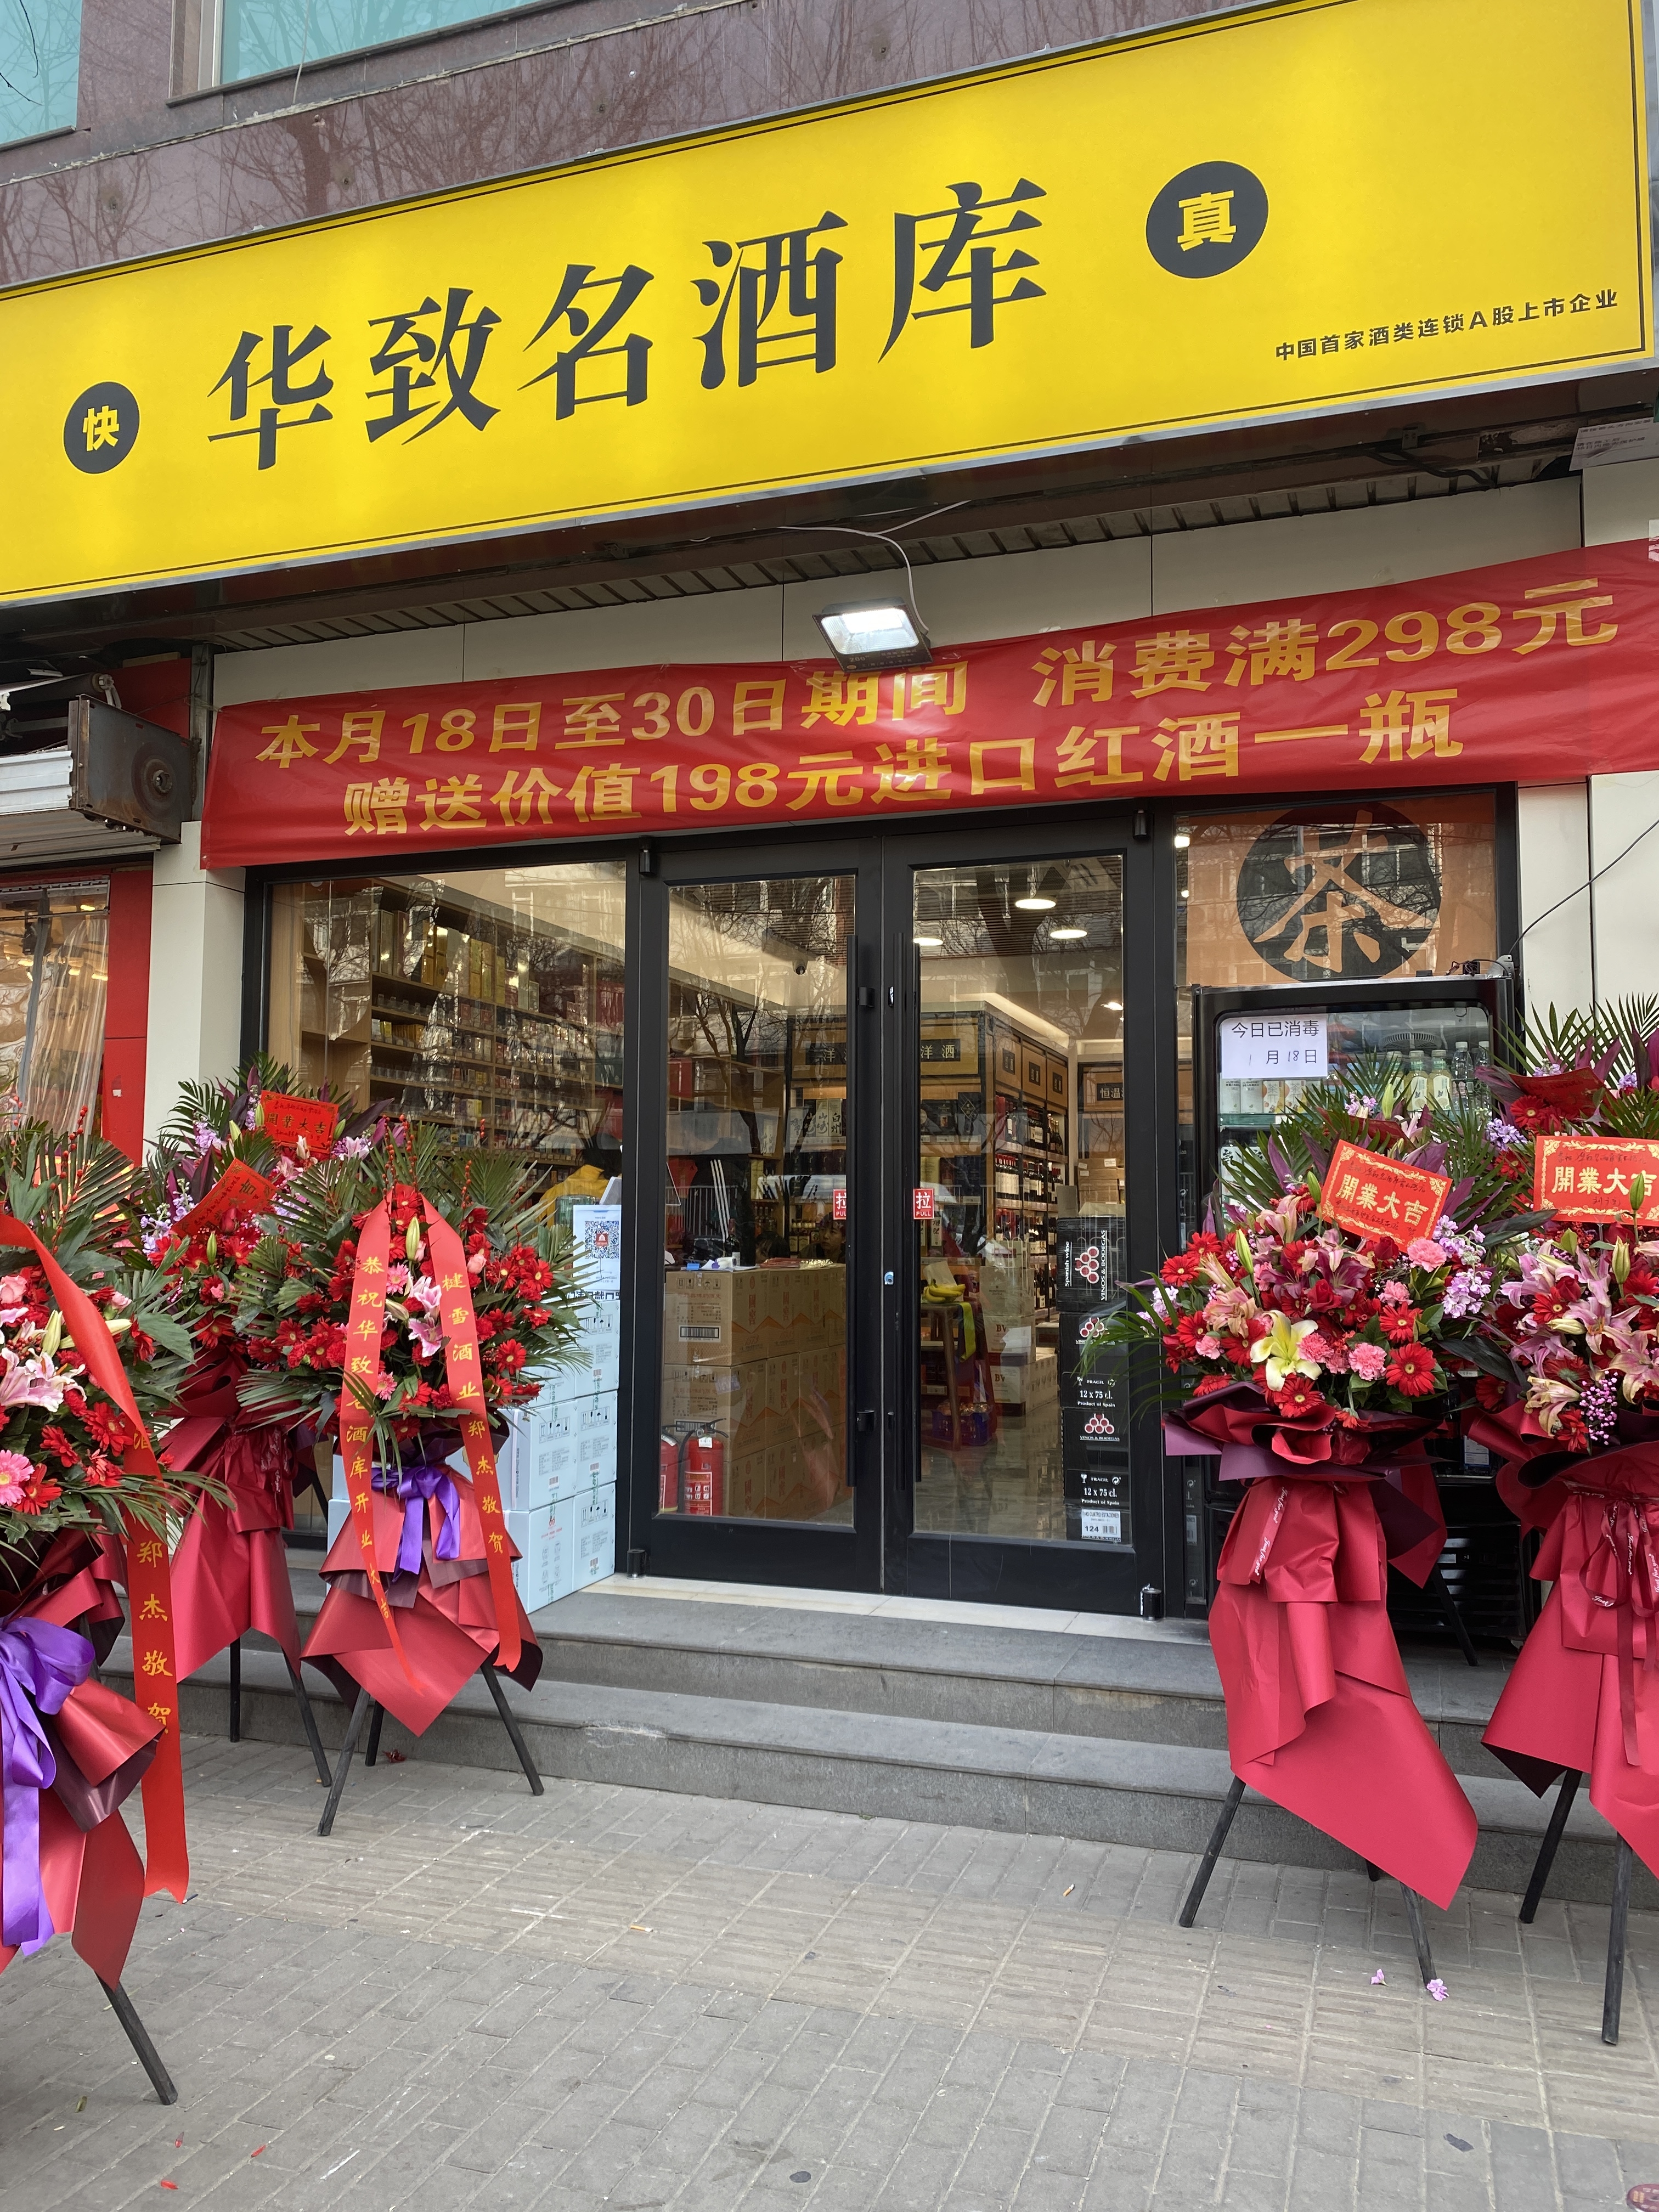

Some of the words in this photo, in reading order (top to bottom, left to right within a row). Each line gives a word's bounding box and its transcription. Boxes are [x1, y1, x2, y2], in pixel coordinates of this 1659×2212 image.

[1178, 189, 1237, 251] 真
[208, 178, 1047, 470] 华致名酒库
[1276, 289, 1618, 362] 中国首家酒类连锁A股上市企业
[83, 405, 119, 451] 快
[255, 658, 969, 768] 本月18日至30日期间
[1032, 578, 1618, 707] 消费满298元
[344, 689, 1463, 836] 赠送价值198元进口红酒一瓶
[1253, 810, 1434, 973] 茶
[1232, 1020, 1319, 1038] 今日已消毒
[823, 1048, 847, 1062] 洋
[921, 1045, 955, 1059] 洋酒
[1100, 1087, 1124, 1099] 恒温
[916, 1192, 932, 1210] 拉
[1335, 1173, 1429, 1226] 開業大吉
[748, 1294, 756, 1325] 國窖
[996, 1324, 1007, 1332] BV
[995, 1374, 1005, 1383] BV
[1095, 1391, 1103, 1399] 75
[1084, 1487, 1092, 1496] 12
[1099, 1488, 1108, 1497] 75
[1109, 1488, 1118, 1498] cl.
